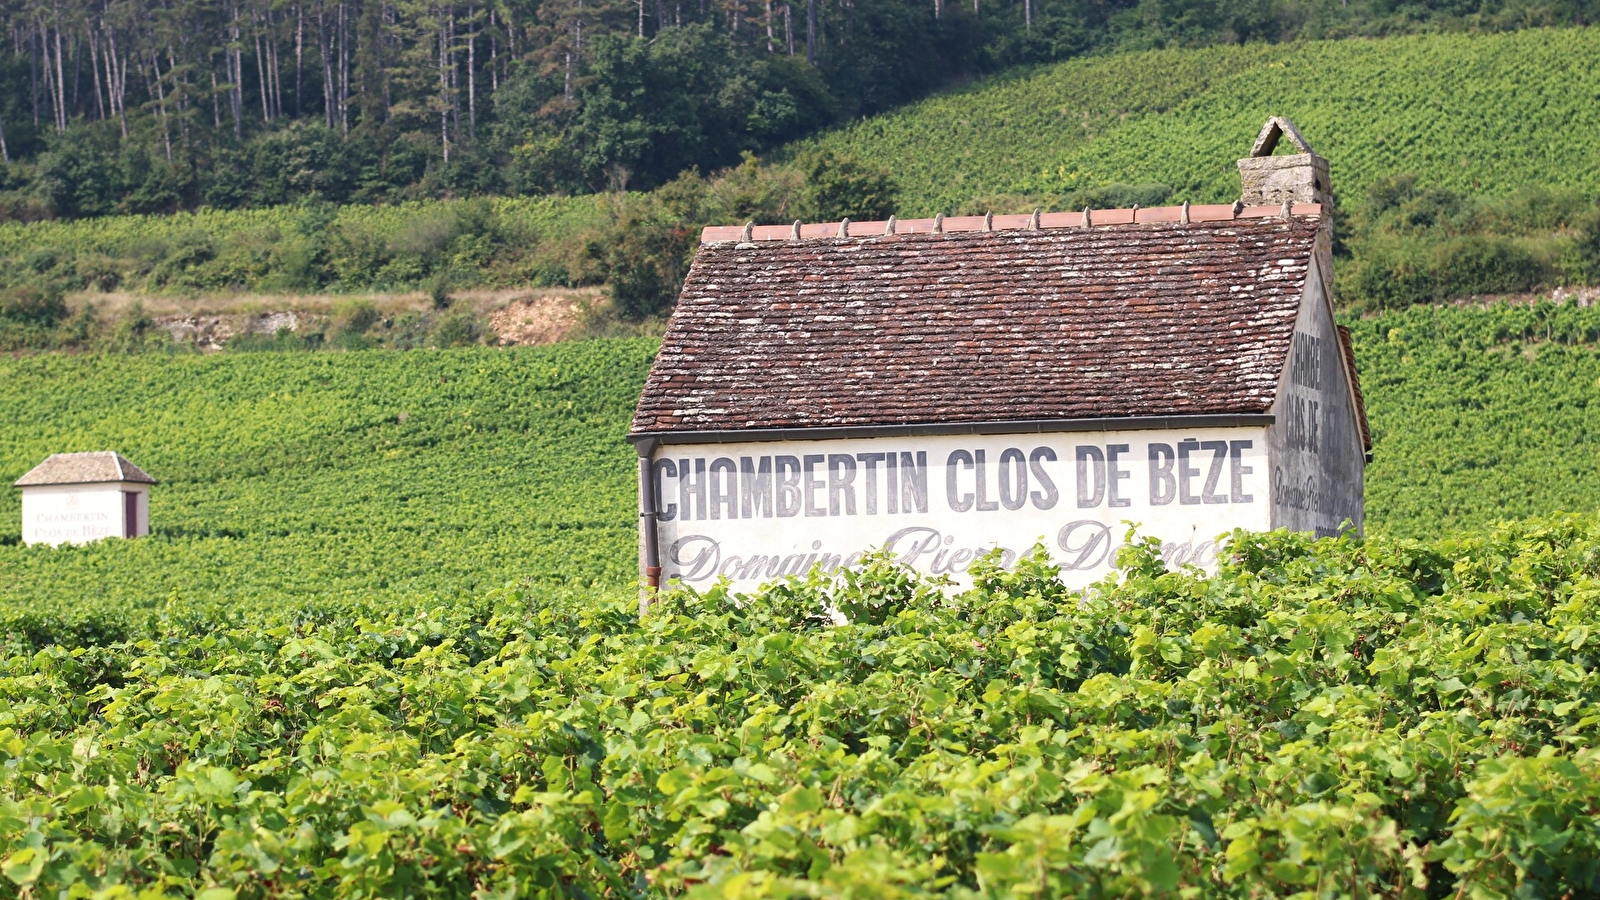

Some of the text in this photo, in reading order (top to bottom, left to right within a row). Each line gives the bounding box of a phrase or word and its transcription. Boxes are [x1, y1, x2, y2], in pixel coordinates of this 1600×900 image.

[1308, 399, 1319, 454] DE
[653, 450, 929, 522] CHAMBERTIN
[945, 445, 1059, 513] CLOS
[1075, 443, 1132, 509] DE
[34, 526, 62, 538] CLOS
[66, 528, 79, 537] DE
[670, 534, 865, 583] Domaine
